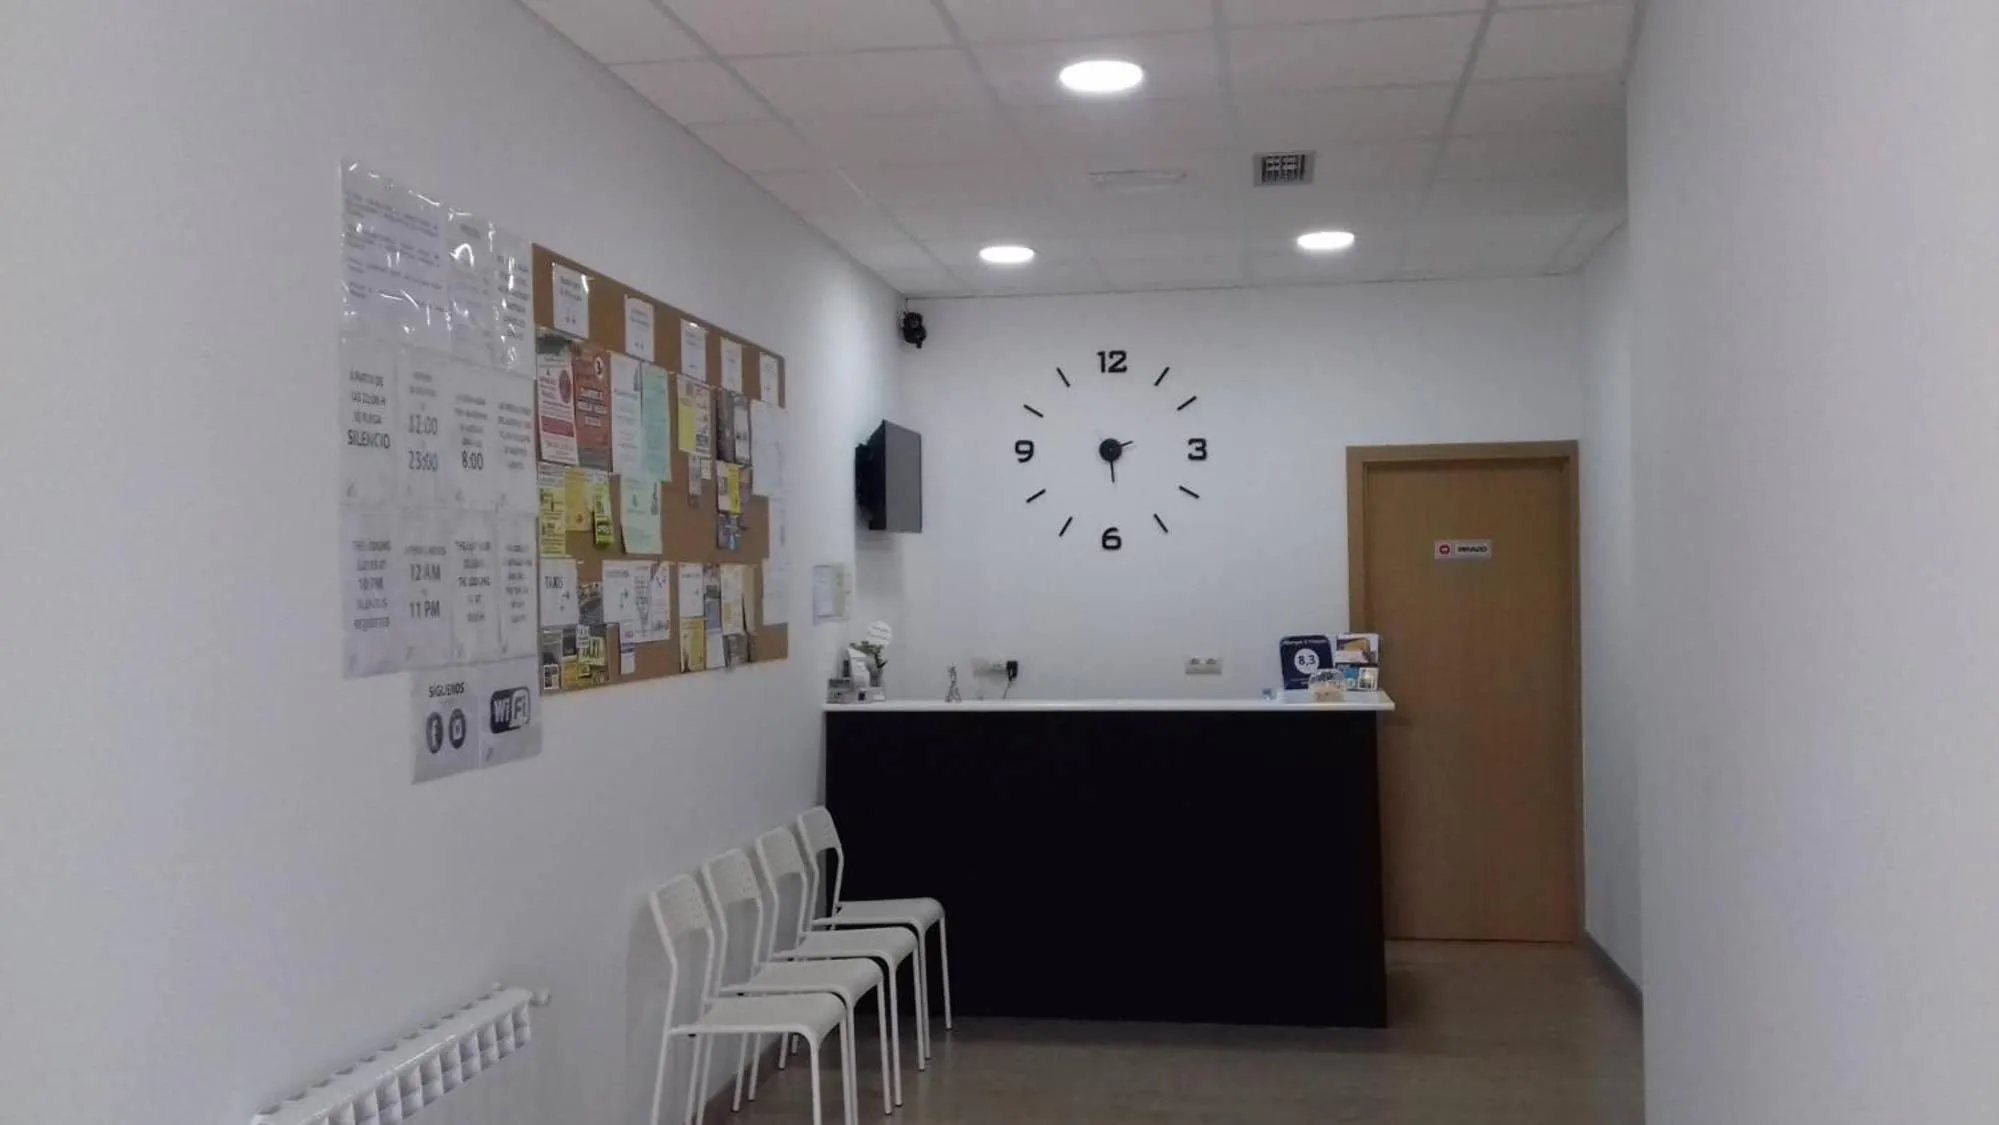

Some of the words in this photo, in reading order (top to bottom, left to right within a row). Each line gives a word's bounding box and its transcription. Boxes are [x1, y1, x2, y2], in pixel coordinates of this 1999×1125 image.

[1097, 350, 1127, 373] 12
[408, 414, 438, 436] 12:00
[347, 429, 391, 450] SILENCIO
[1188, 438, 1208, 461] 3
[462, 450, 484, 471] 8:00
[1015, 440, 1035, 463] 9
[1101, 527, 1122, 550] 6
[409, 563, 422, 581] 12
[423, 563, 442, 583] AM
[409, 601, 421, 619] 11
[423, 600, 441, 619] PM
[1298, 655, 1317, 667] 8,3
